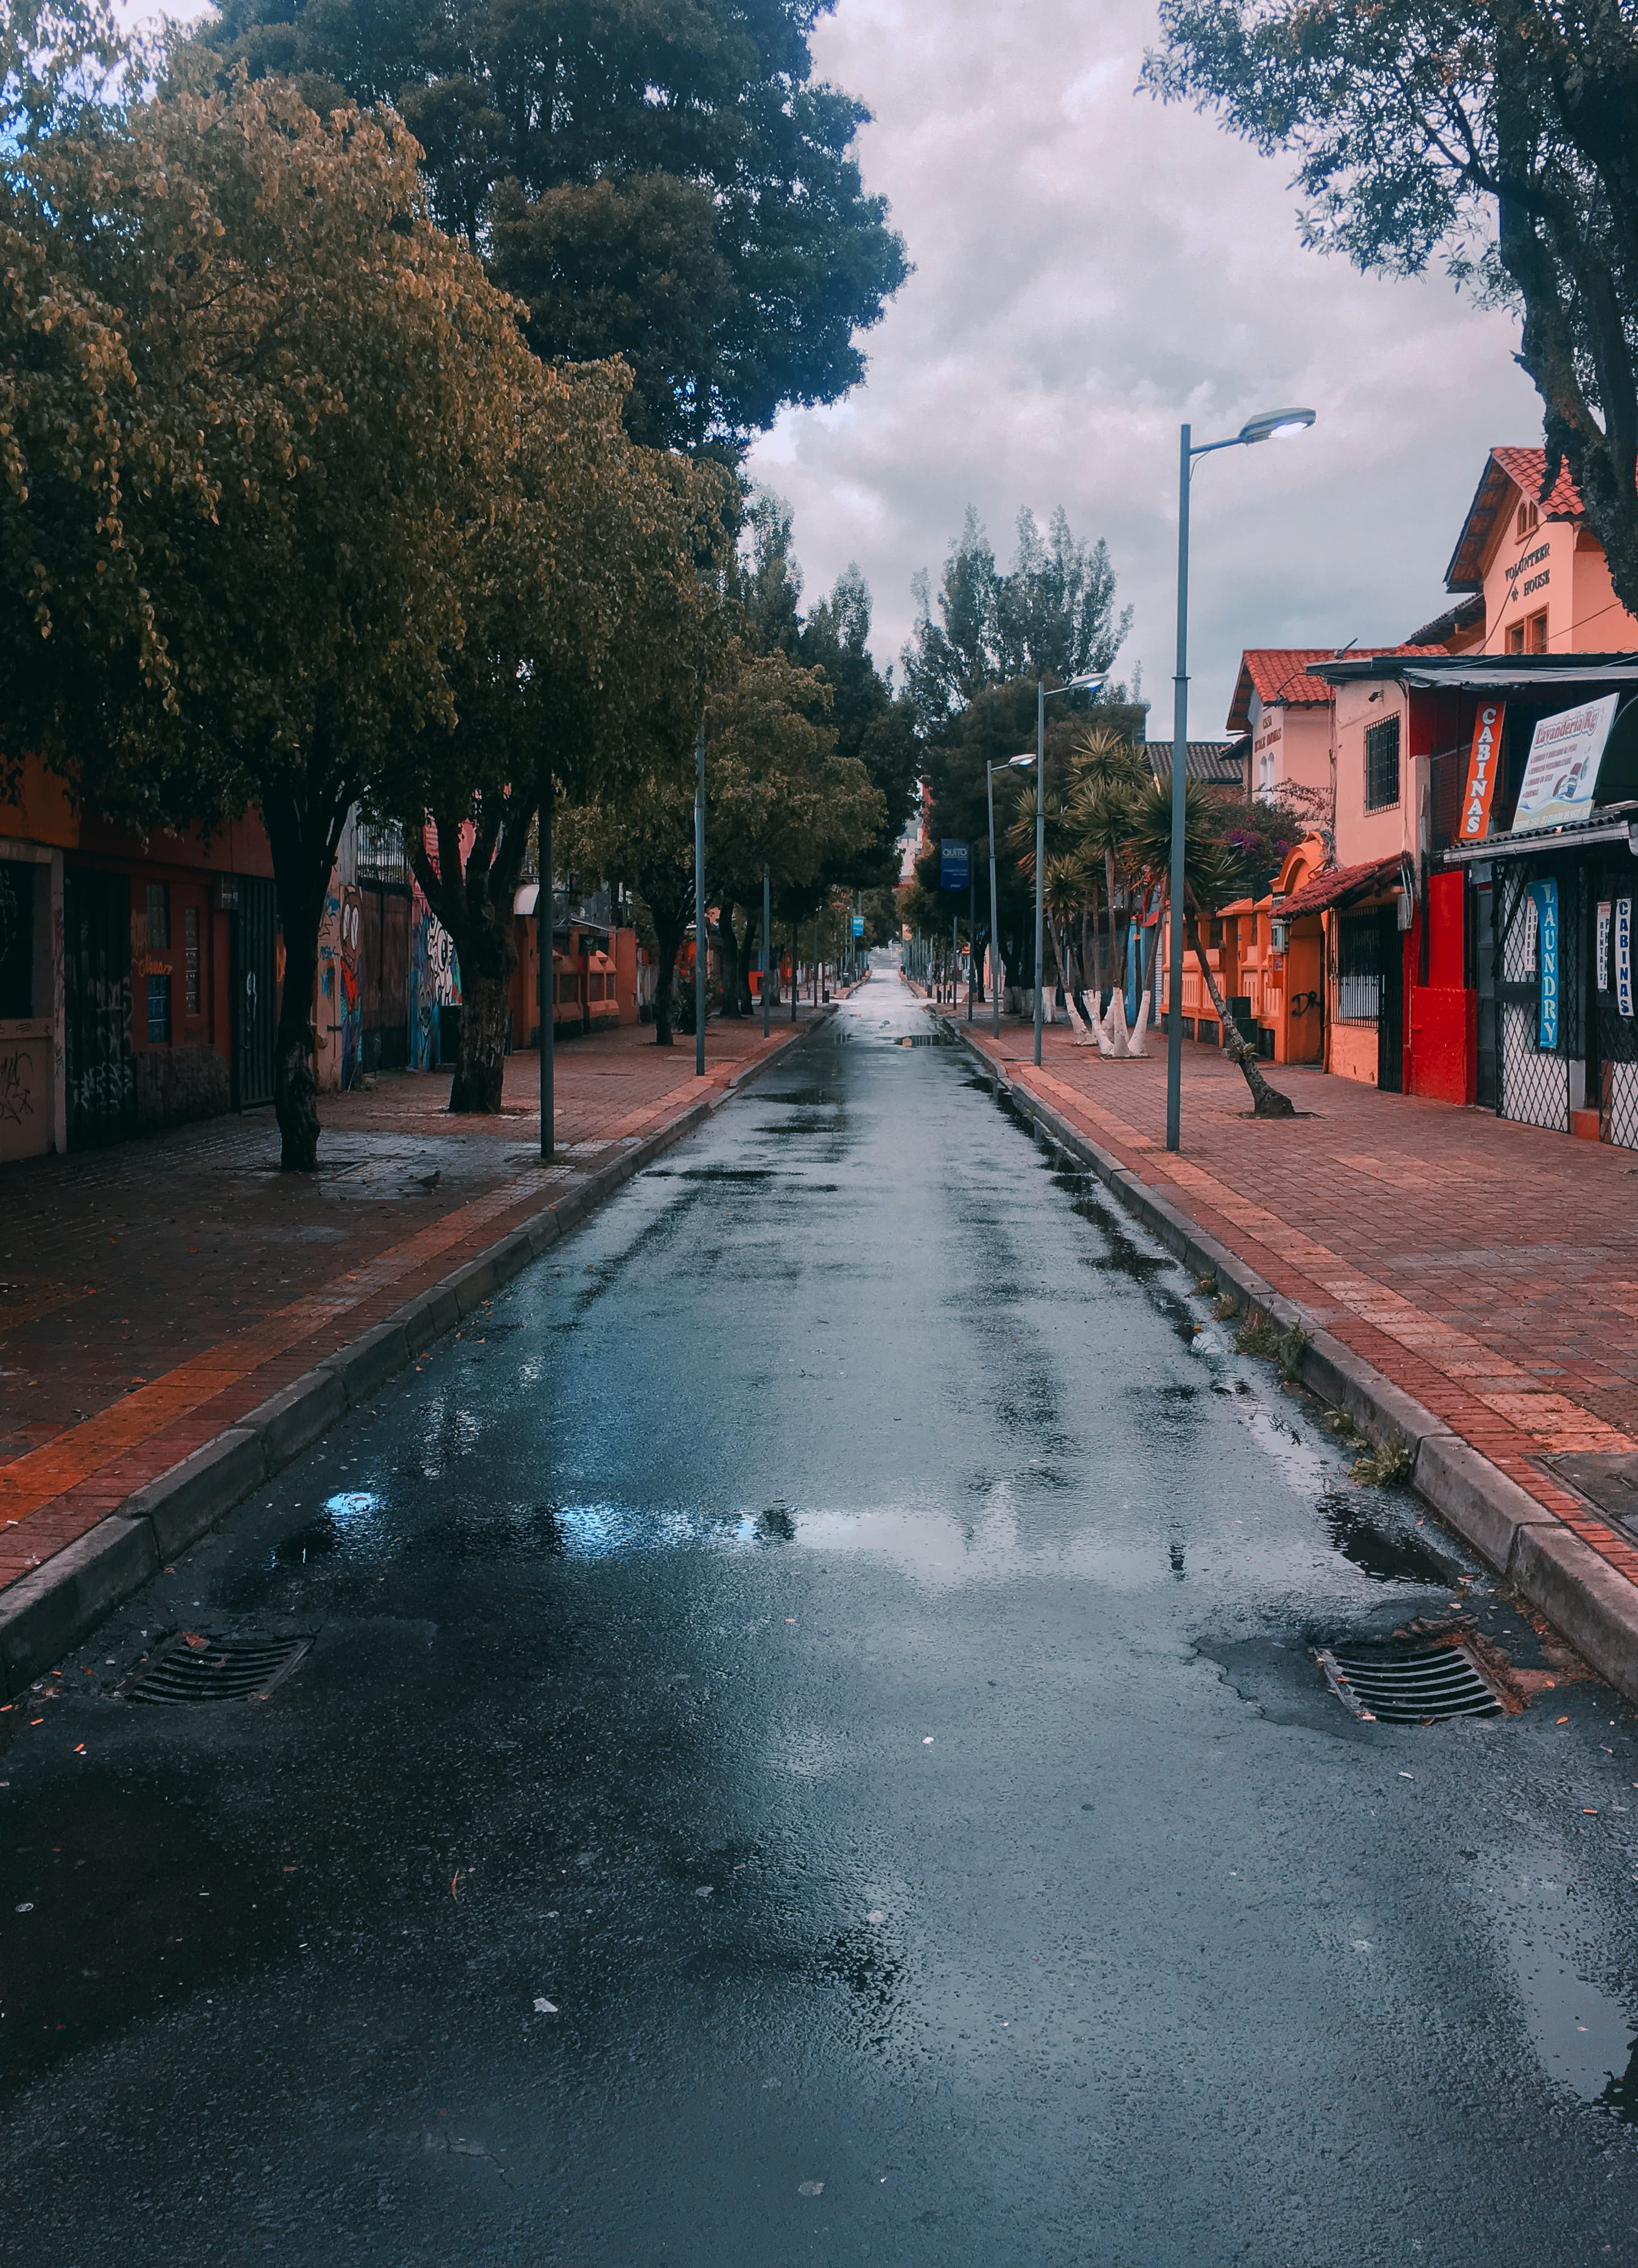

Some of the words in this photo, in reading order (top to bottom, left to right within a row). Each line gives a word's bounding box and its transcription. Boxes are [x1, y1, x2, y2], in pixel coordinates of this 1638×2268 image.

[1505, 542, 1550, 582] VOLUNTEER
[1524, 568, 1550, 596] HOUSE
[1467, 708, 1496, 833] CABINAS
[1541, 884, 1556, 1042] LAUNDRY
[1619, 901, 1629, 1014] CABINAS
